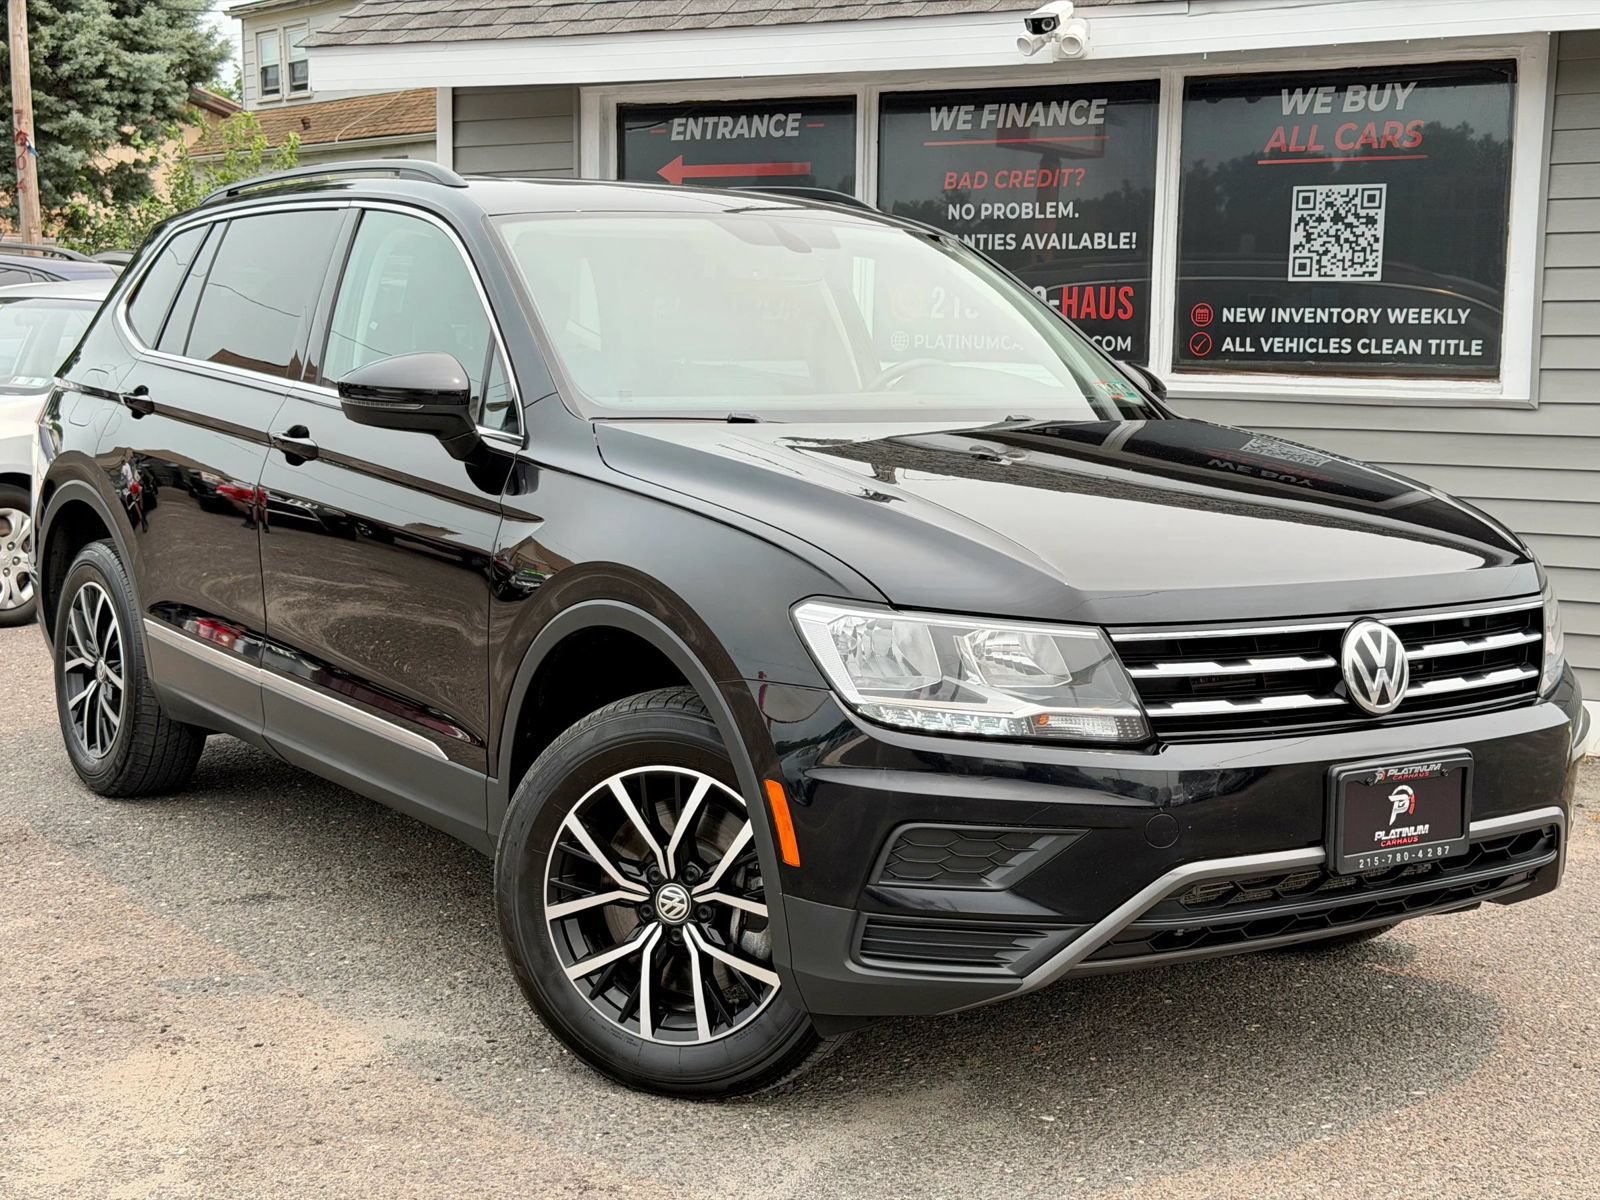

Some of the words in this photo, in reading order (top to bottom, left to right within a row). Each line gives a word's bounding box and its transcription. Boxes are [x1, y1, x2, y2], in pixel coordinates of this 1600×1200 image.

[1281, 86, 1337, 116] WE
[1342, 82, 1418, 113] BUY
[929, 105, 975, 132] WE
[980, 98, 1108, 130] FINANCE
[670, 112, 802, 142] ENTRANCE
[1263, 123, 1325, 154] ALL
[1334, 119, 1425, 150] CARS
[943, 171, 989, 191] BAD
[994, 167, 1087, 189] CREDIT?
[947, 202, 975, 221] NO
[980, 201, 1080, 220] PROBLEM.
[953, 233, 1017, 251] NTIES
[1021, 231, 1137, 251] AVAILABLE!
[1221, 307, 1267, 324] NEW
[1271, 307, 1383, 325] INVENTORY
[1386, 308, 1472, 325] WEEKLY
[1221, 336, 1256, 353] ALL
[1260, 337, 1352, 354] VEHICLES
[1357, 338, 1422, 355] CLEAN
[1428, 339, 1483, 356] TITLE
[1387, 763, 1442, 777] PLATINUM
[1374, 824, 1430, 841] PLATINUM
[1380, 836, 1419, 847] CARHAUS
